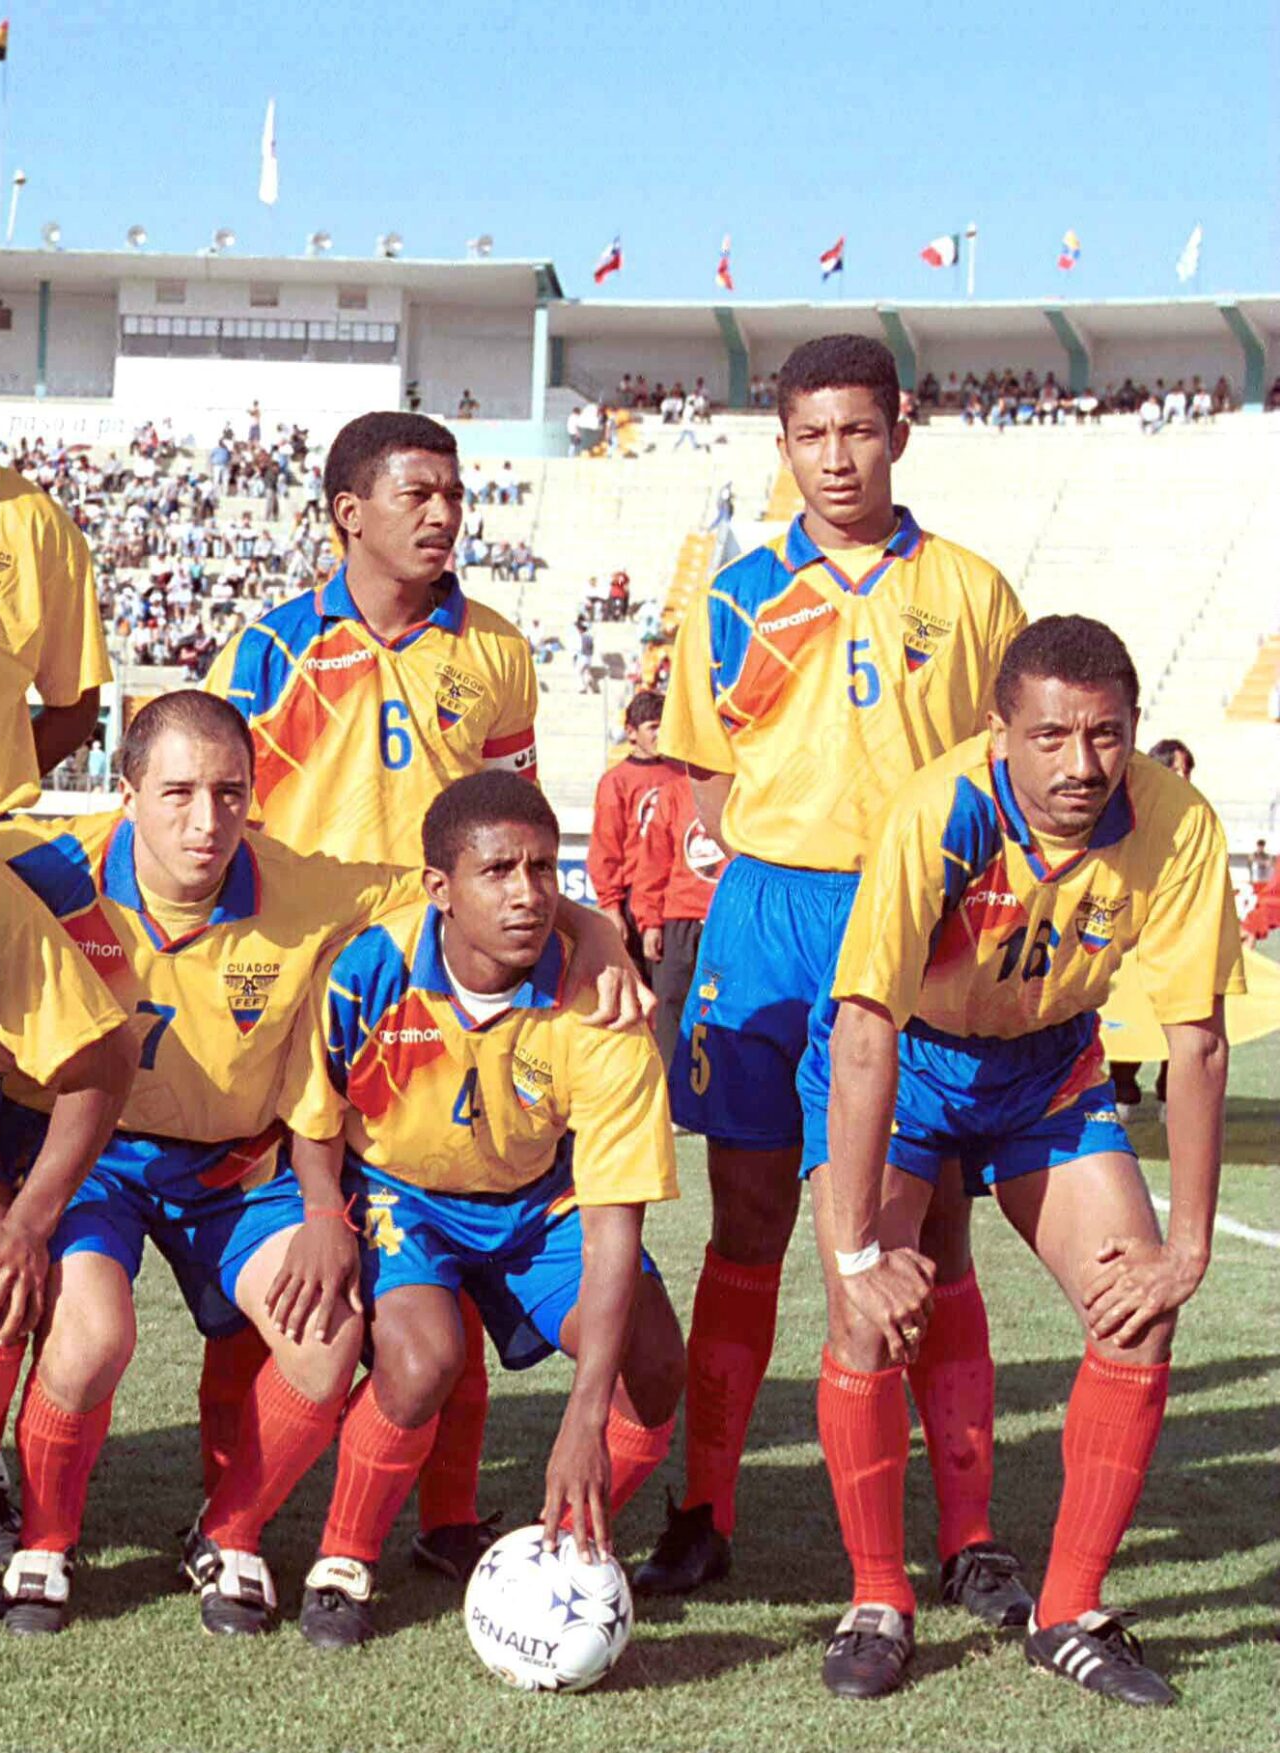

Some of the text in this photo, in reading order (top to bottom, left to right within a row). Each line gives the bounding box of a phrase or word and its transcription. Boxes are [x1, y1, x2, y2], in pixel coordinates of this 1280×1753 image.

[758, 602, 833, 634] marathon
[304, 650, 373, 672] marathon
[846, 638, 882, 708] 5
[379, 699, 413, 771] 6
[76, 940, 123, 958] athon
[226, 963, 281, 973] CUADOR
[997, 918, 1061, 983] 16
[234, 997, 260, 1008] FEF
[136, 1000, 177, 1070] 7
[689, 1023, 711, 1097] 5
[472, 1605, 559, 1660] PENALTY
